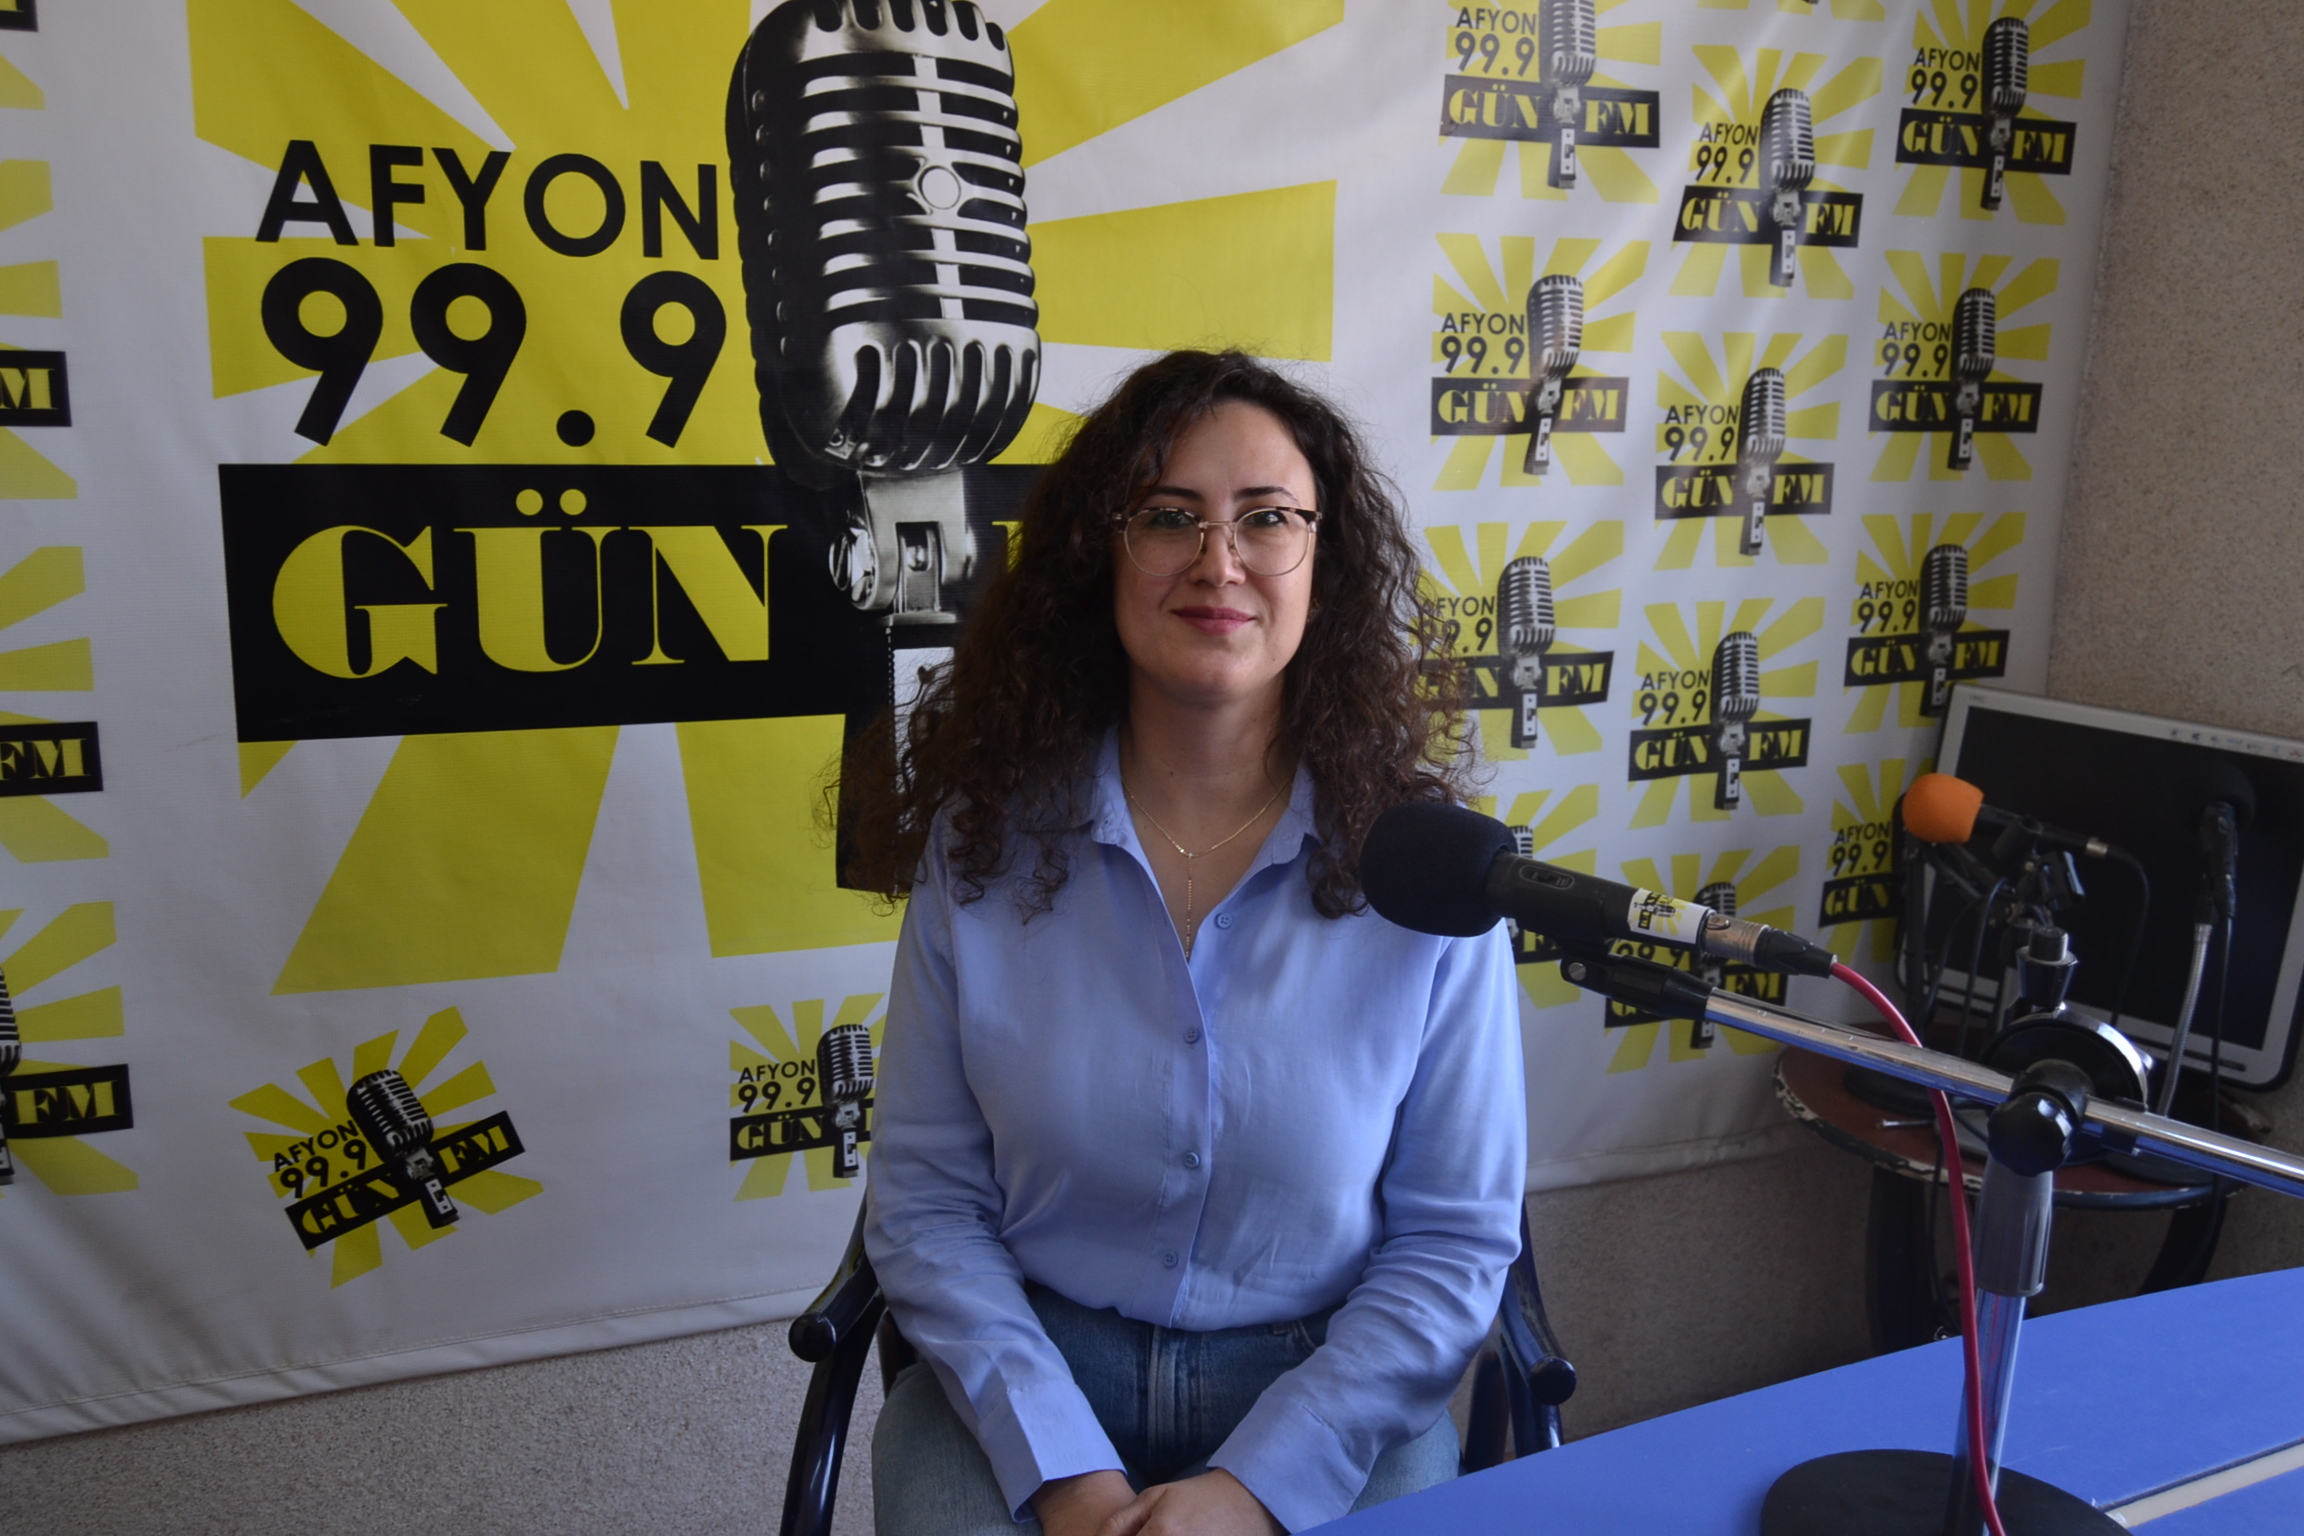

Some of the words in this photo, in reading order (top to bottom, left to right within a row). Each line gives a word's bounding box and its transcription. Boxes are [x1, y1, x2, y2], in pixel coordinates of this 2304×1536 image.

[1456, 7, 1537, 35] AFYON
[1455, 31, 1535, 77] 99.9
[1914, 47, 1980, 72] AFYON
[1911, 69, 1978, 109] 99.9
[1449, 84, 1541, 129] GÜN
[1584, 99, 1652, 136] FM
[1699, 122, 1758, 146] AFYON
[1903, 116, 1983, 156] GÜN
[2011, 129, 2067, 163] FM
[1695, 145, 1755, 184] 99.9
[256, 140, 719, 260] AFYON
[1682, 191, 1762, 233] GÜN
[1804, 202, 1857, 236] FM
[1441, 312, 1525, 335] AFYON
[1883, 321, 1951, 342] AFYON
[261, 257, 727, 448] 99.9
[1440, 335, 1525, 375] 99.9
[1882, 342, 1948, 377] 99.9
[1438, 383, 1530, 424] GÜN
[1559, 389, 1620, 421] FM
[1665, 405, 1739, 425] AFYON
[1876, 385, 1950, 422] GÜN
[1981, 393, 2033, 422] FM
[1664, 426, 1735, 462] 99.9
[1662, 469, 1737, 508] GÜN
[1772, 474, 1826, 505] FM
[273, 489, 788, 678] GÜN
[1860, 580, 1918, 599] AFYON
[1858, 599, 1917, 633] 99.9
[1851, 639, 1919, 676] GÜN
[1954, 640, 2001, 670] FM
[1546, 663, 1607, 697] FM
[1640, 669, 1710, 691] AFYON
[1639, 690, 1707, 726] 99.9
[1635, 731, 1710, 771] GÜN
[1748, 729, 1803, 761] FM
[1834, 821, 1890, 845] AFYON
[1832, 840, 1888, 877] 99.9
[1825, 879, 1891, 916] GÜN
[739, 1059, 815, 1084] AFYON
[10, 1080, 122, 1125] FM
[738, 1077, 816, 1113] 99.9
[274, 1120, 360, 1171] AFYON
[737, 1114, 823, 1150] GÜN
[280, 1139, 367, 1198] 99.9
[302, 1172, 400, 1234] GÜN
[438, 1124, 510, 1174] FM
